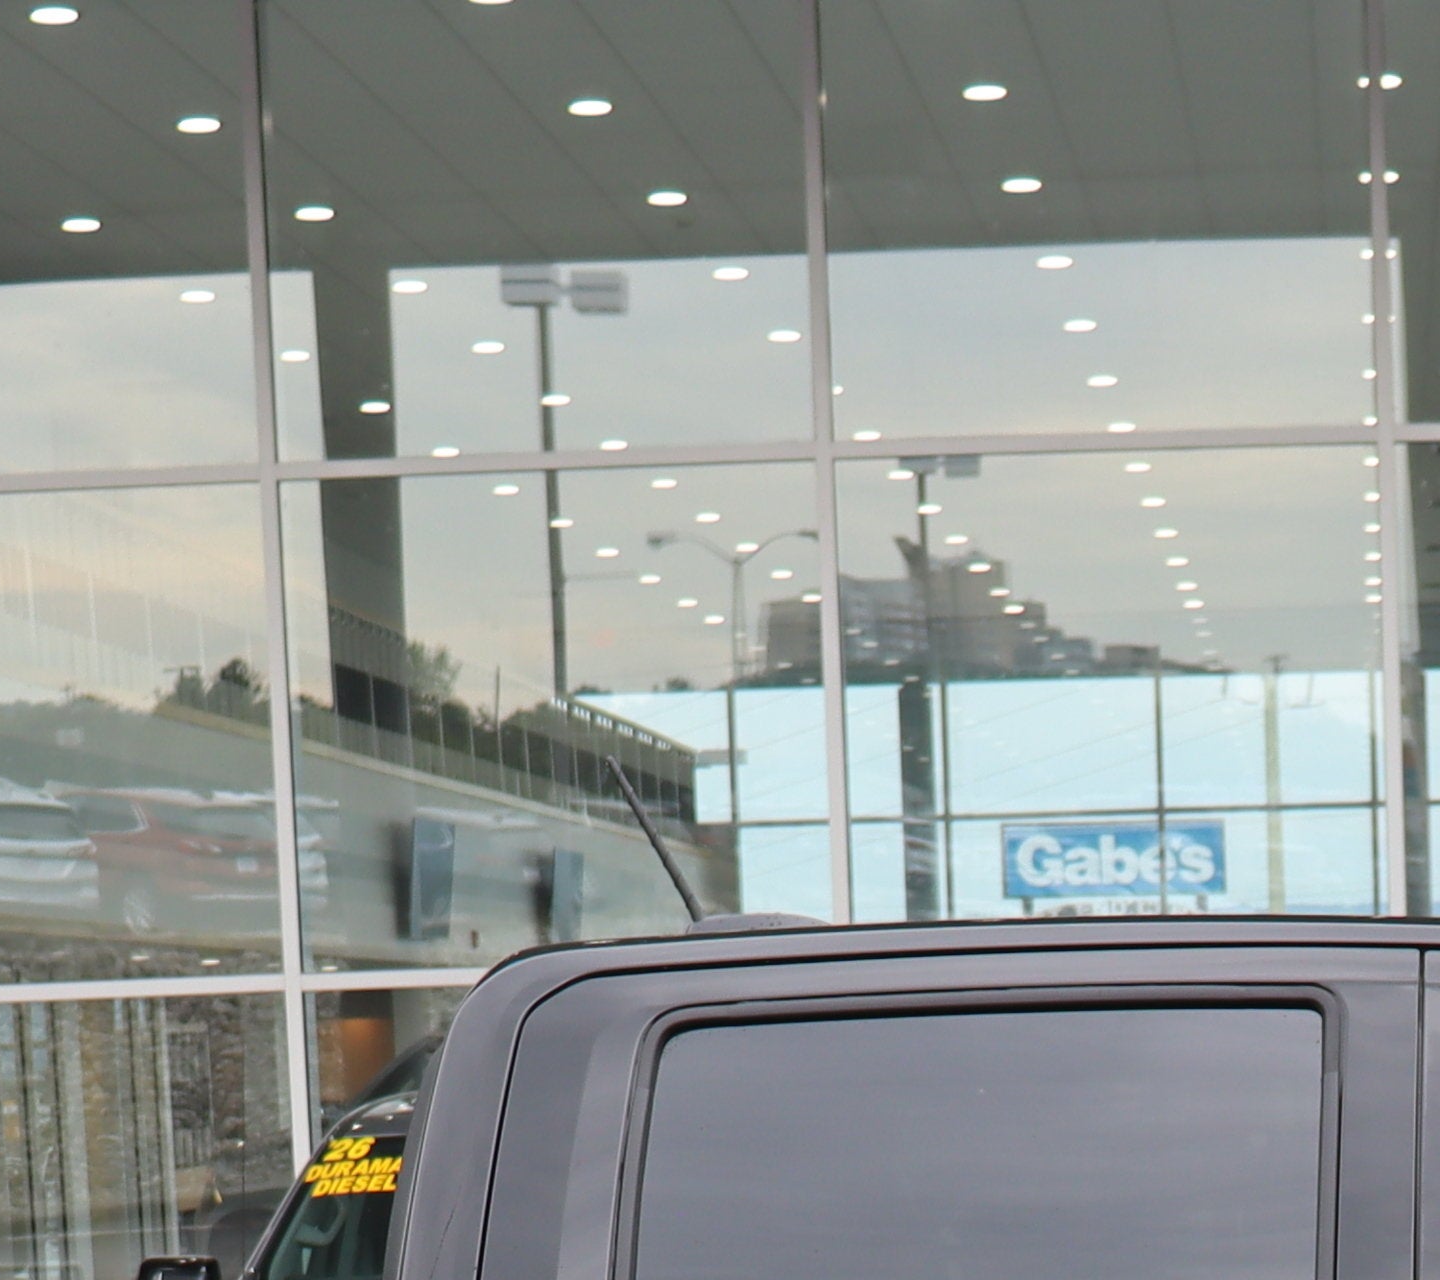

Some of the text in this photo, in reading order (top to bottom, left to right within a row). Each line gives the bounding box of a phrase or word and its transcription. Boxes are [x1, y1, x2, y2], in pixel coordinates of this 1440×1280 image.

[1016, 833, 1216, 888] Gabe's
[323, 1136, 376, 1162] '26
[305, 1157, 403, 1183] DURAMA
[311, 1174, 397, 1198] DIESEL
